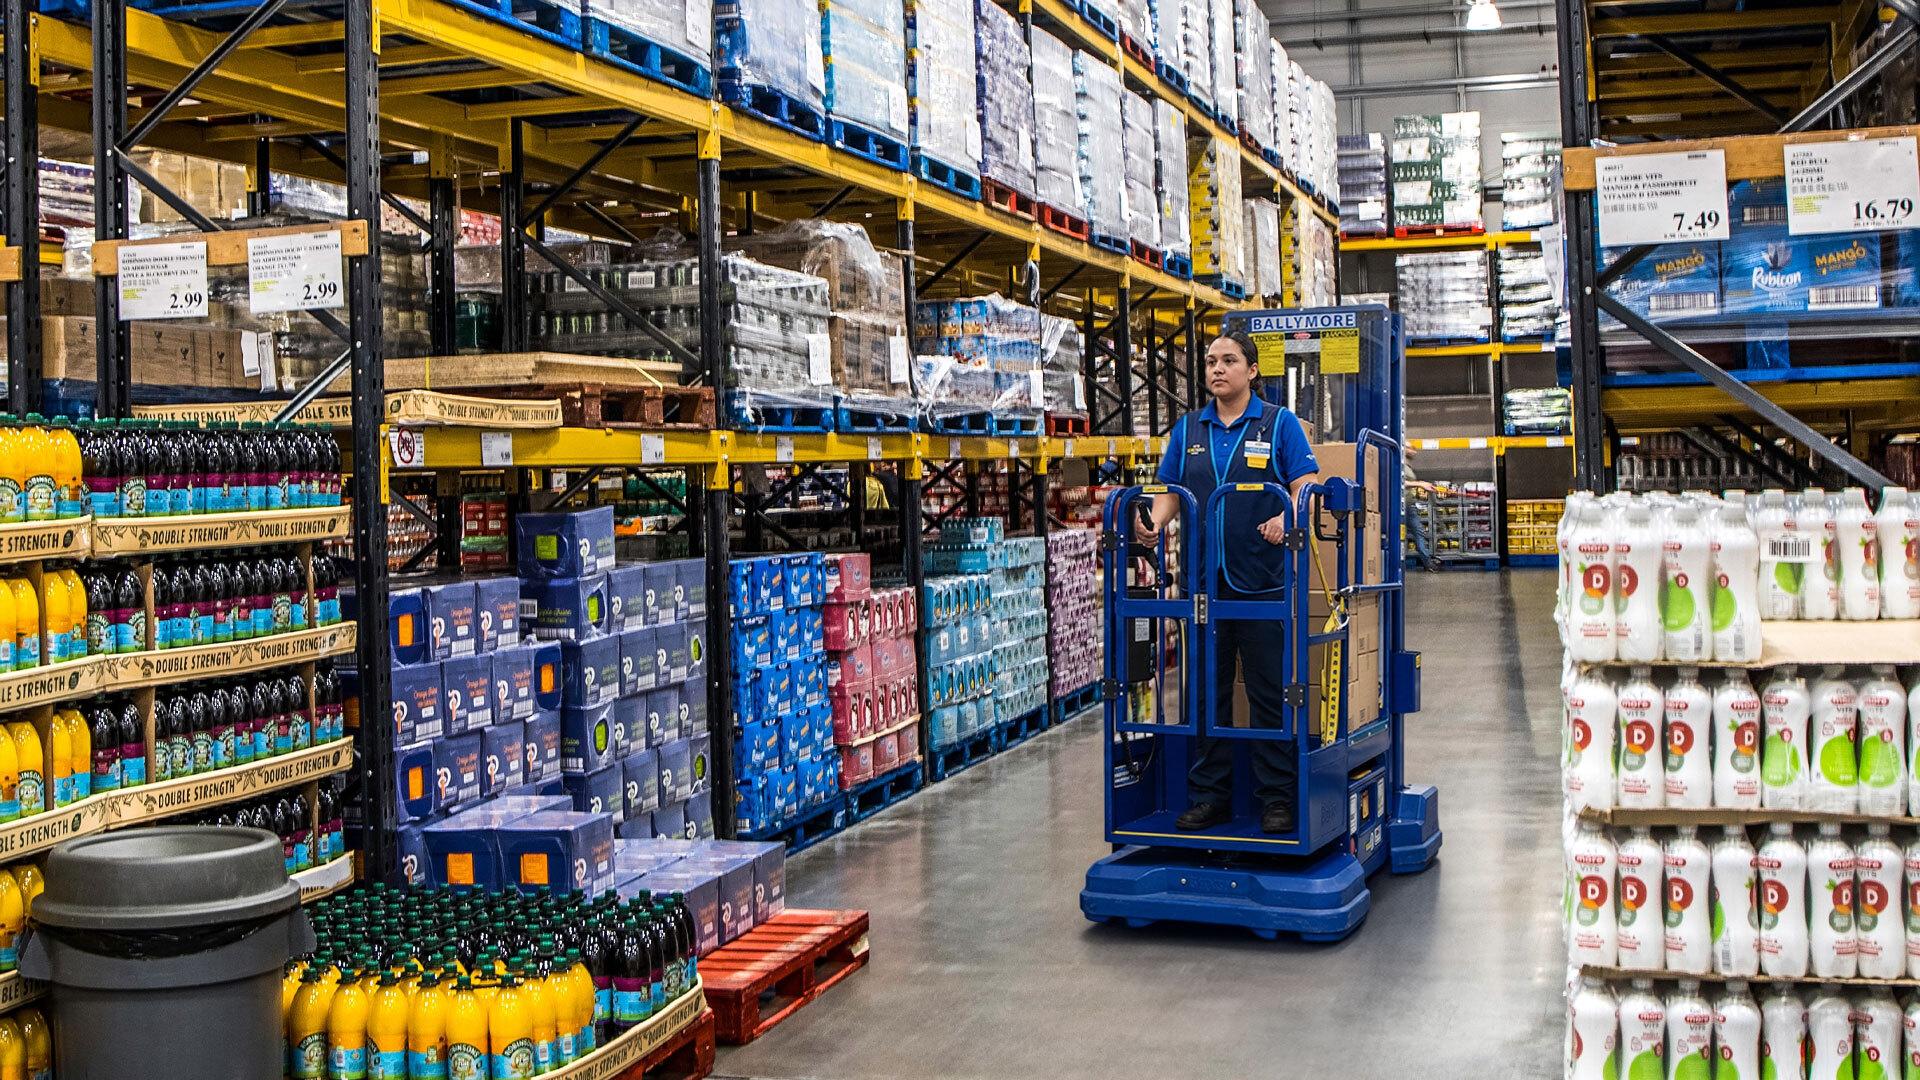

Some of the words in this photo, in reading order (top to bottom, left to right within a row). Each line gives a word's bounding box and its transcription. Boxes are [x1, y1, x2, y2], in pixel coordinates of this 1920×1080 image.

[1854, 198, 1914, 220] 16.79
[1672, 210, 1720, 232] 7.49
[1655, 253, 1705, 273] MANGO
[1815, 246, 1867, 267] MANGO
[303, 282, 338, 300] 2.99
[170, 292, 202, 309] 2.99
[1253, 314, 1354, 330] BALLYMORE
[447, 404, 467, 416] DOUBLE
[469, 406, 495, 418] STRENGTH
[511, 409, 528, 420] DOUBLE
[152, 529, 184, 546] DOUBLE
[188, 526, 229, 544] STRENGTH
[258, 523, 288, 538] DOUBLE
[290, 520, 326, 537] STRENGTH
[8, 532, 60, 552] STRENGTH
[1592, 573, 1604, 588] D
[260, 645, 290, 660] DOUBLE
[292, 636, 327, 655] STRENGTH
[155, 656, 188, 674] DOUBLE
[191, 652, 232, 671] STRENGTH
[15, 676, 66, 700] STRENGTH
[1622, 701, 1649, 709] more
[1634, 730, 1646, 744] D
[1674, 730, 1685, 744] D
[1744, 730, 1754, 746] D
[264, 767, 293, 784] DOUBLE
[295, 756, 330, 778] STRENGTH
[158, 790, 192, 809] DOUBLE
[194, 779, 235, 802] STRENGTH
[20, 818, 68, 848] STRENGTH
[1576, 856, 1604, 864] more
[1587, 884, 1600, 900] D
[1626, 884, 1638, 900] D
[1672, 886, 1684, 902] D
[1768, 888, 1779, 904] D
[1842, 888, 1851, 904] D
[1867, 888, 1878, 904] D
[649, 1028, 668, 1046] DOUBLE
[668, 1004, 694, 1029] STRENGTH
[574, 1066, 598, 1080] DOUBLE
[600, 1048, 628, 1073] STRENGTH
